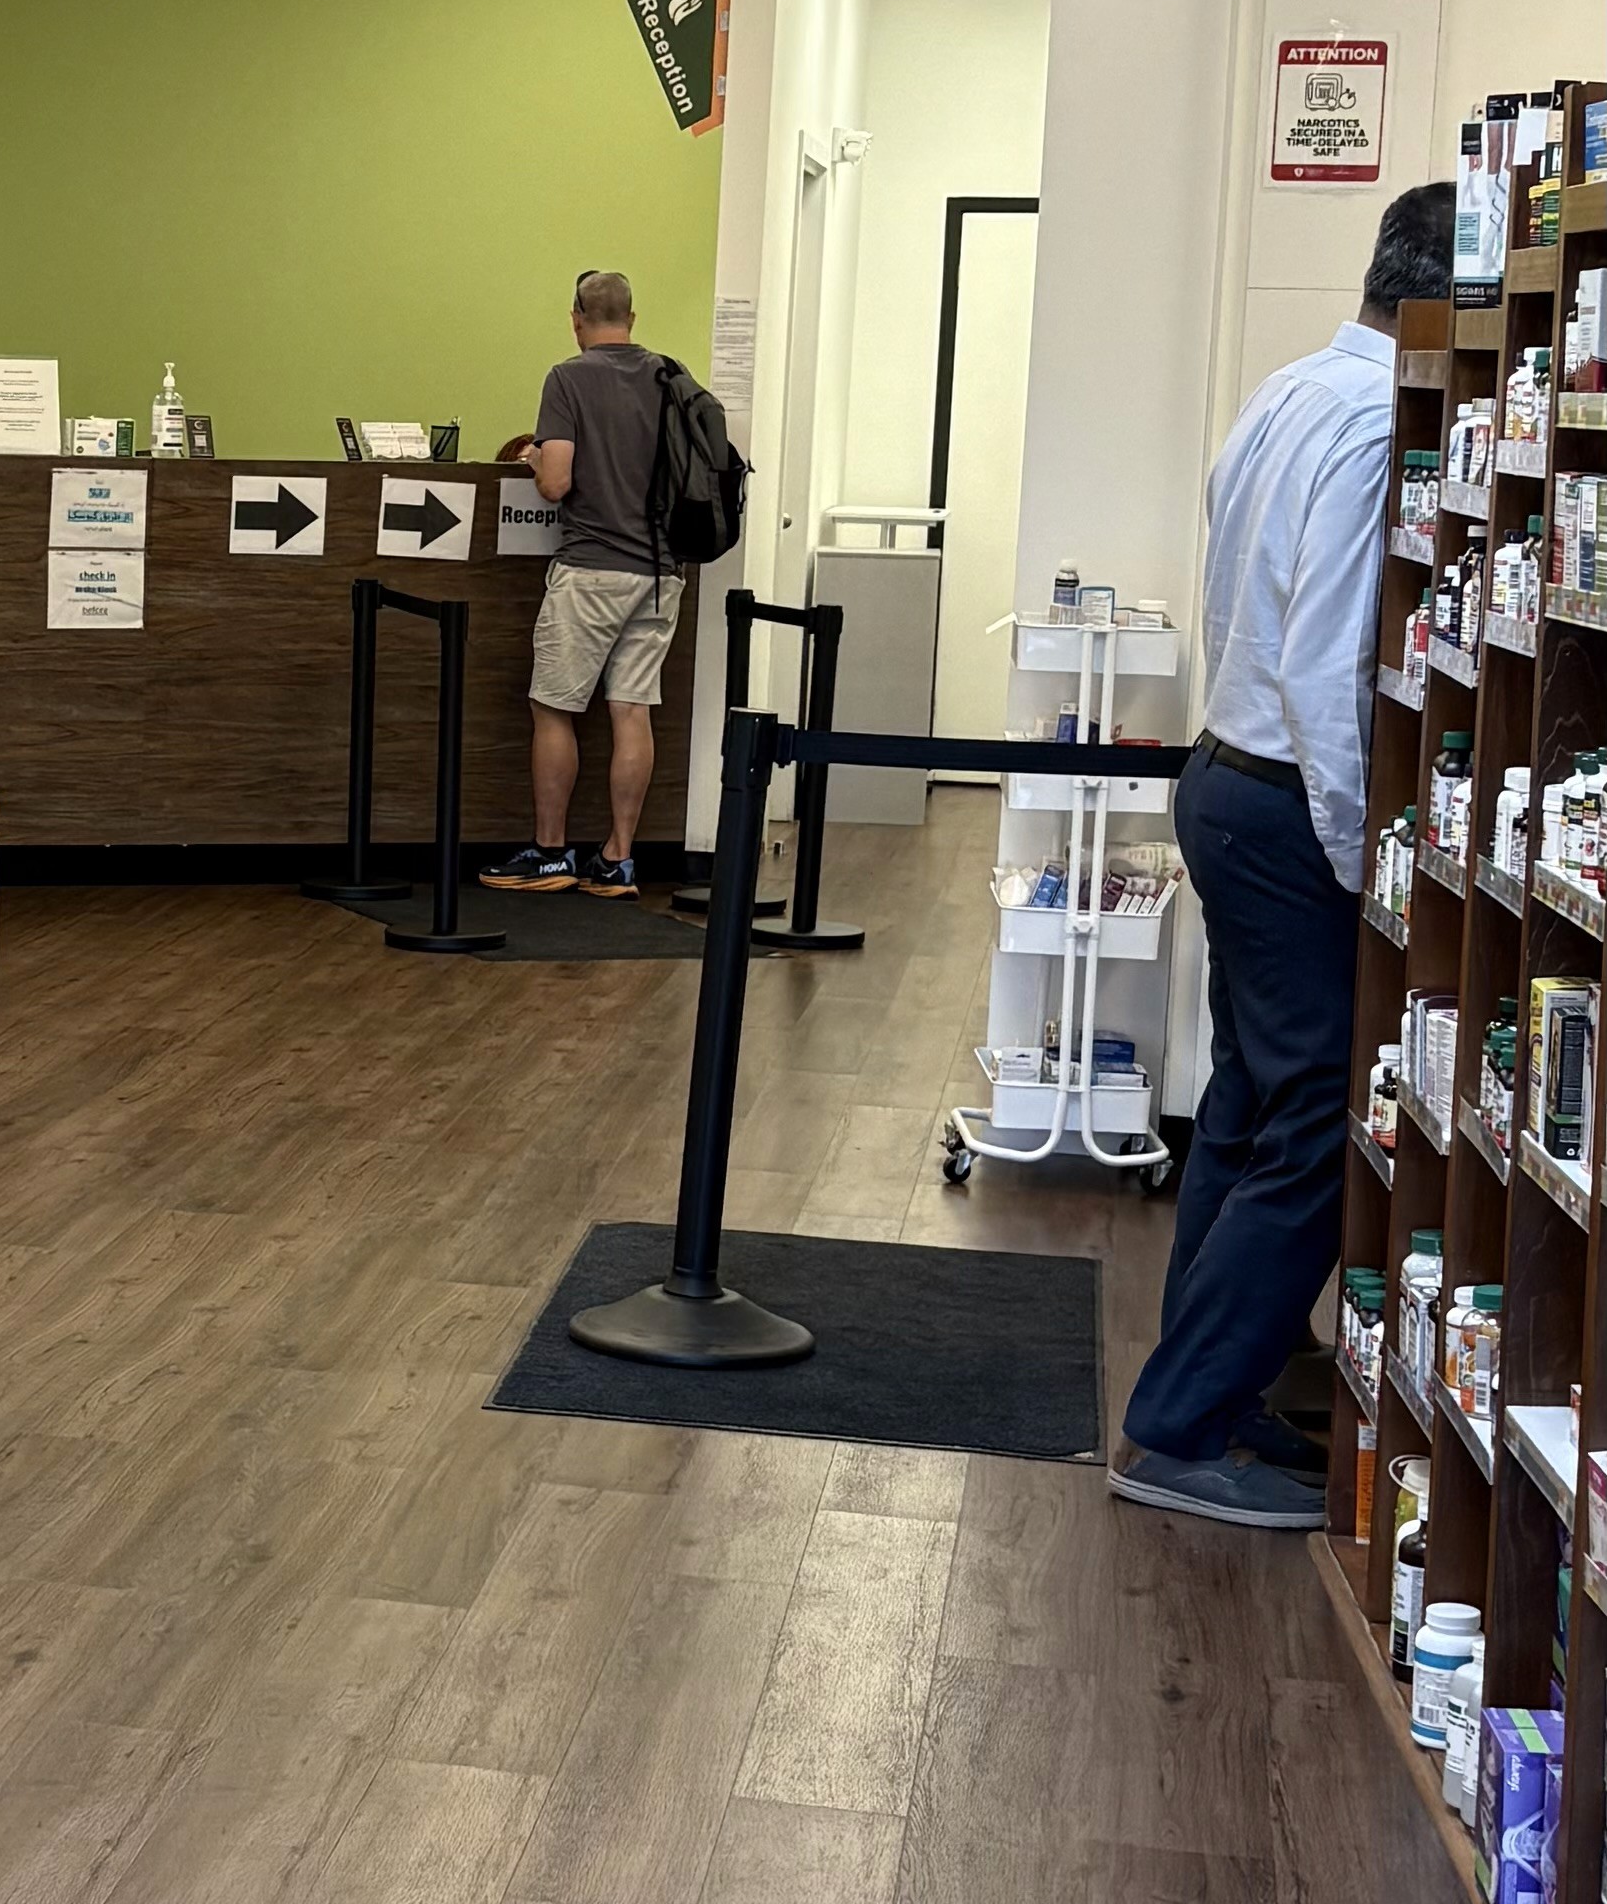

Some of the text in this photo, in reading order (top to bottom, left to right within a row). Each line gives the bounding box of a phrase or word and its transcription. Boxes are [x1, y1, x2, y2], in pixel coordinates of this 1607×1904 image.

[1287, 48, 1379, 61] ATTENTION
[1297, 118, 1360, 127] NARCOTICS
[1290, 128, 1366, 137] SECURED IN A
[1286, 138, 1369, 147] TIME-DELAYED
[1312, 148, 1340, 157] SAFE
[539, 861, 568, 875] HOKA
